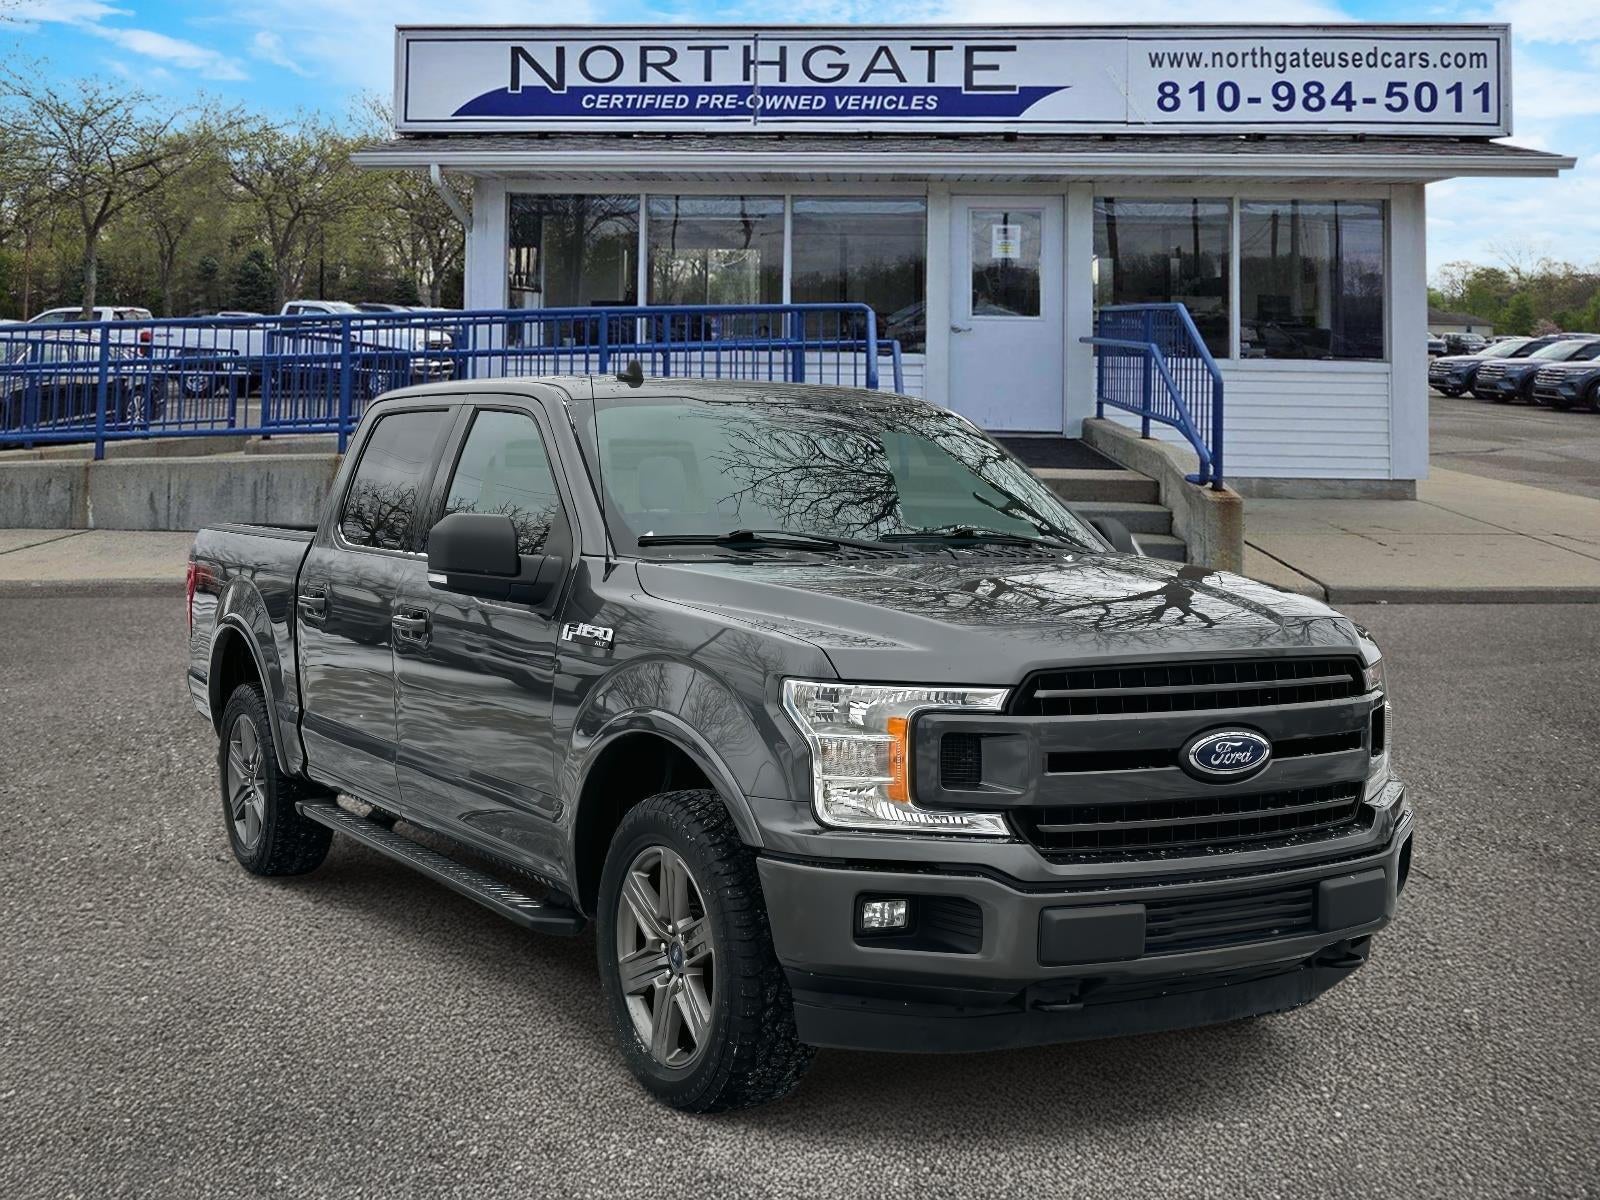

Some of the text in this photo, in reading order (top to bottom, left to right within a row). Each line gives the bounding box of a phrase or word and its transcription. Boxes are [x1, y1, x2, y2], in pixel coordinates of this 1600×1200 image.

[510, 44, 1018, 92] NORTHGATE
[1148, 46, 1488, 73] www.northgateusedcars.com
[581, 94, 938, 111] CERTIFIED PRE-OWNED VEHICLES
[1156, 81, 1491, 113] 810-984-5011
[1210, 741, 1254, 765] Ford
